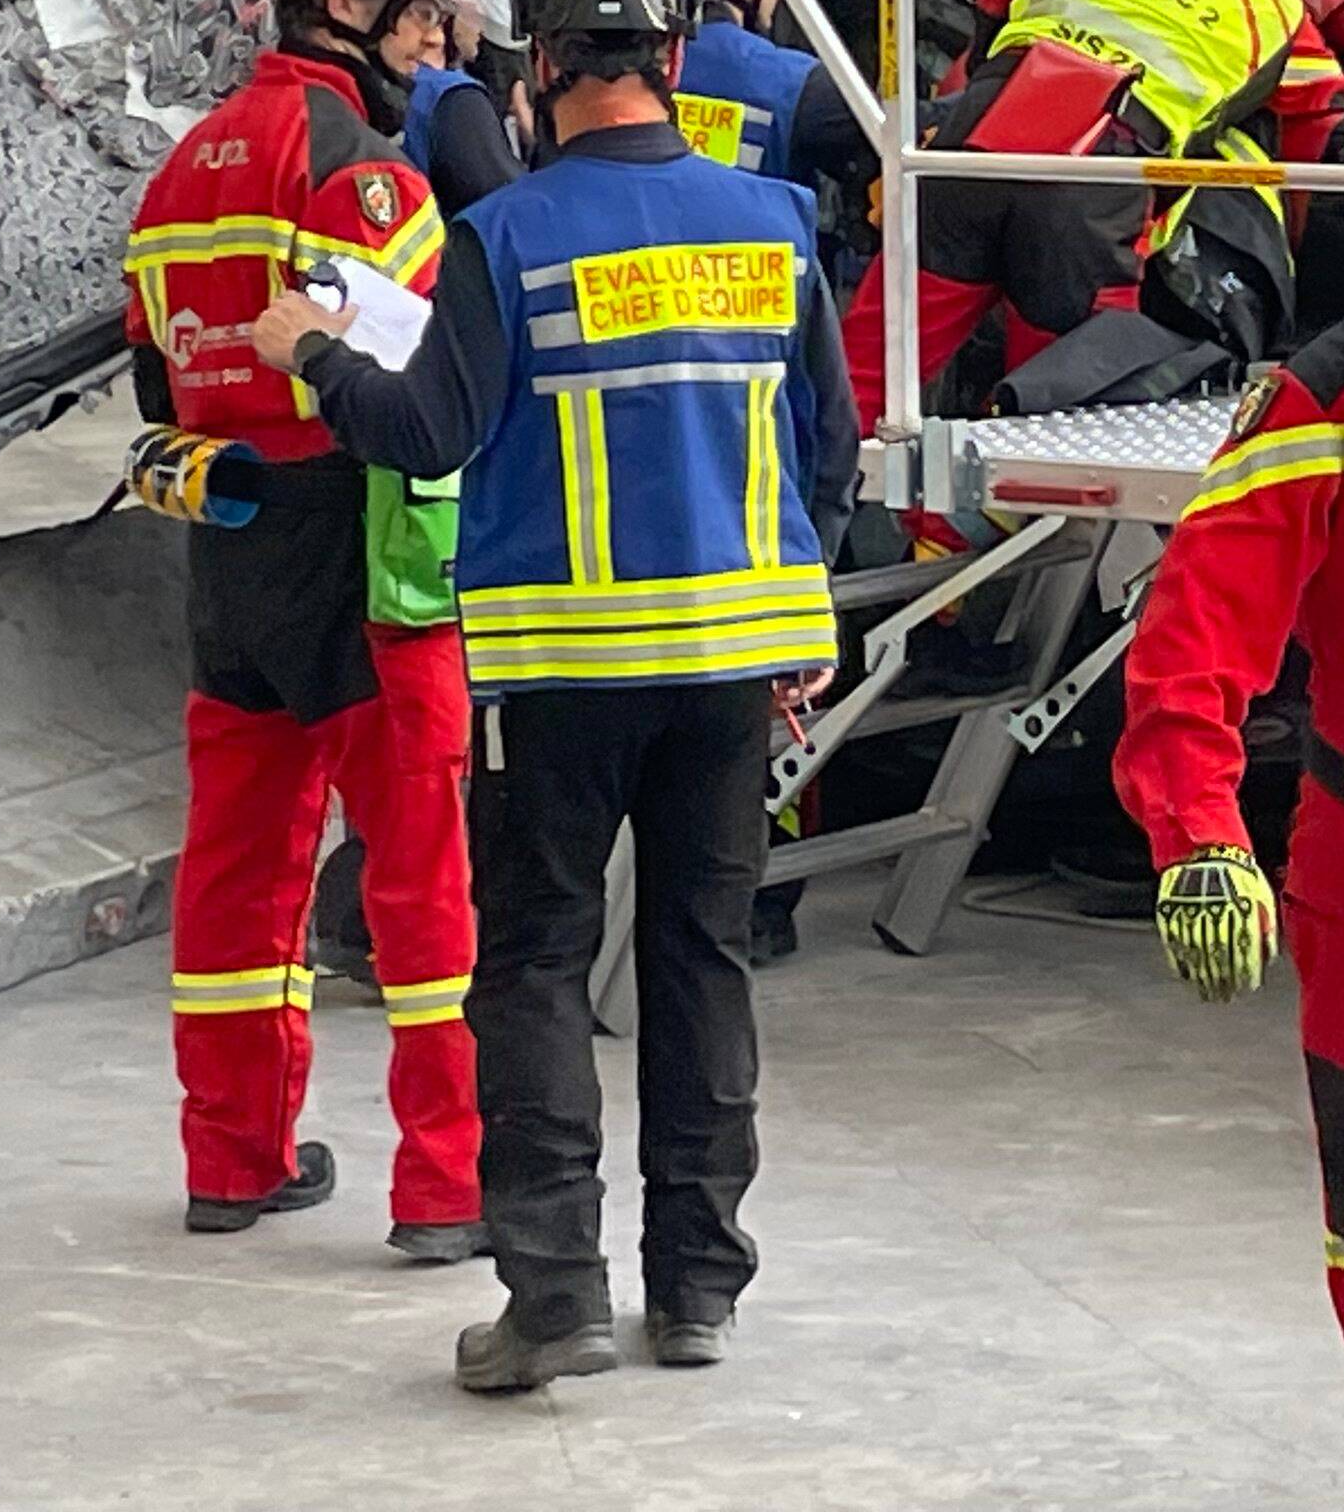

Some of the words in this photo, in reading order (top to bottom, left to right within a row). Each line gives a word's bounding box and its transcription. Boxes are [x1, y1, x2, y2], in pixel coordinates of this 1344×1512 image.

[1198, 6, 1221, 31] 2
[677, 99, 735, 131] EUR
[582, 252, 786, 296] EVALUATEUR
[589, 291, 663, 331] CHEF
[698, 287, 786, 318] EQUIPE
